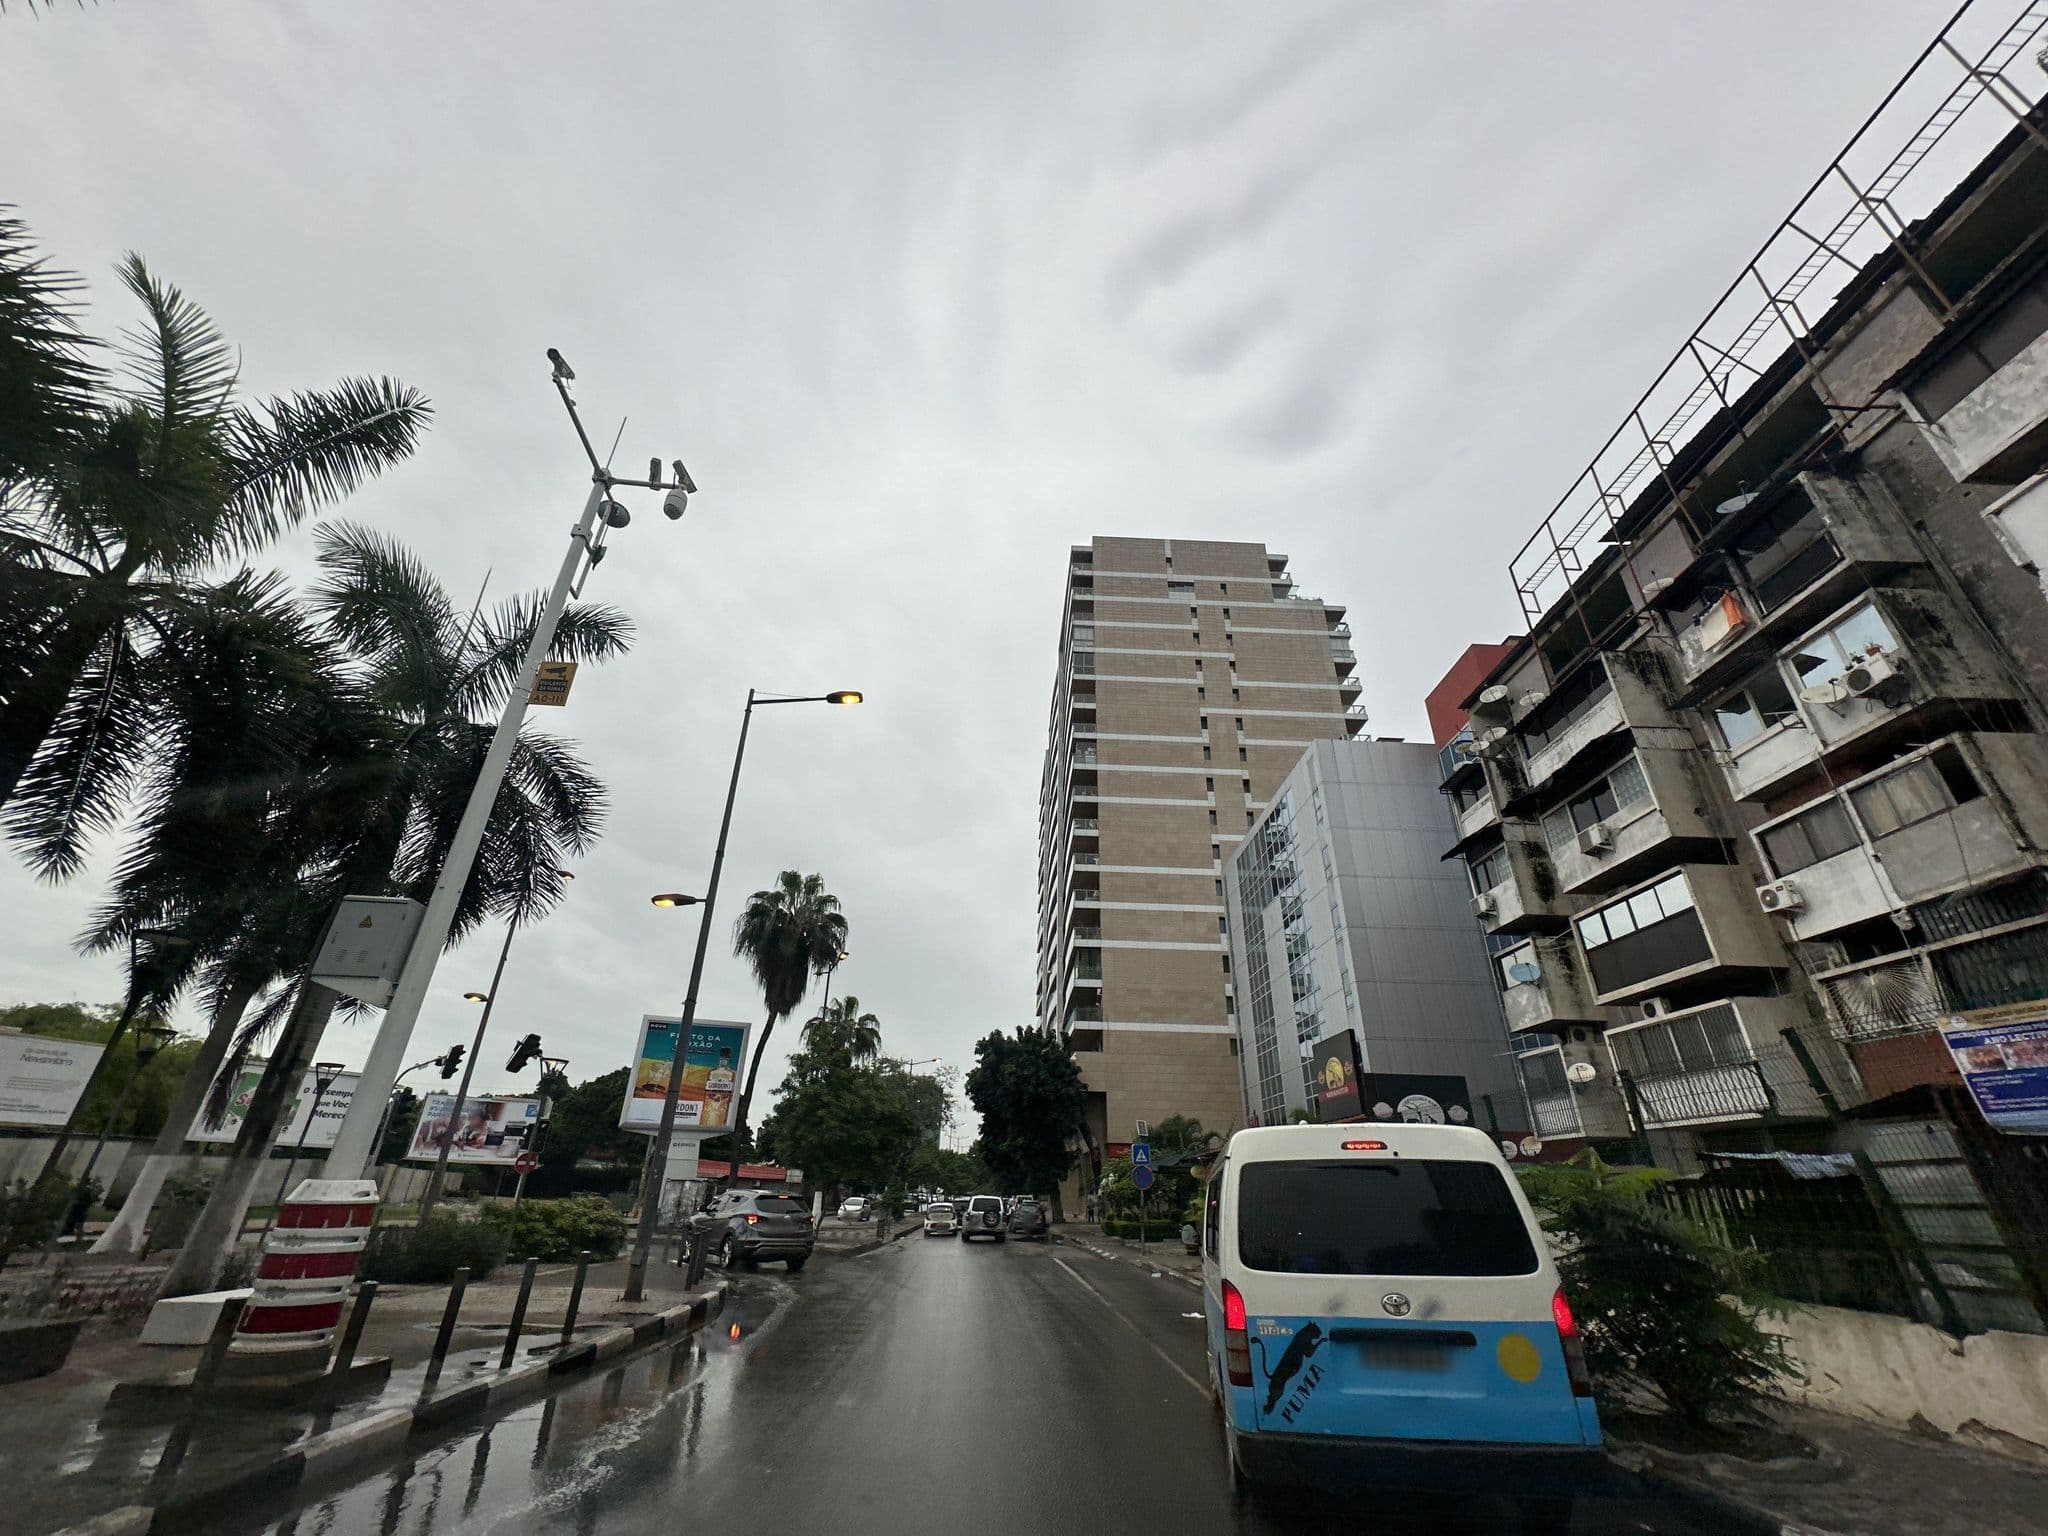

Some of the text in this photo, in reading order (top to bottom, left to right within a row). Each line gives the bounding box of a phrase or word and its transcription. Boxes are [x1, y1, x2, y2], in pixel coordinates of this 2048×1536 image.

[670, 1032, 705, 1041] FTO
[332, 1100, 349, 1108] Voc
[1281, 1364, 1326, 1424] PUMA
